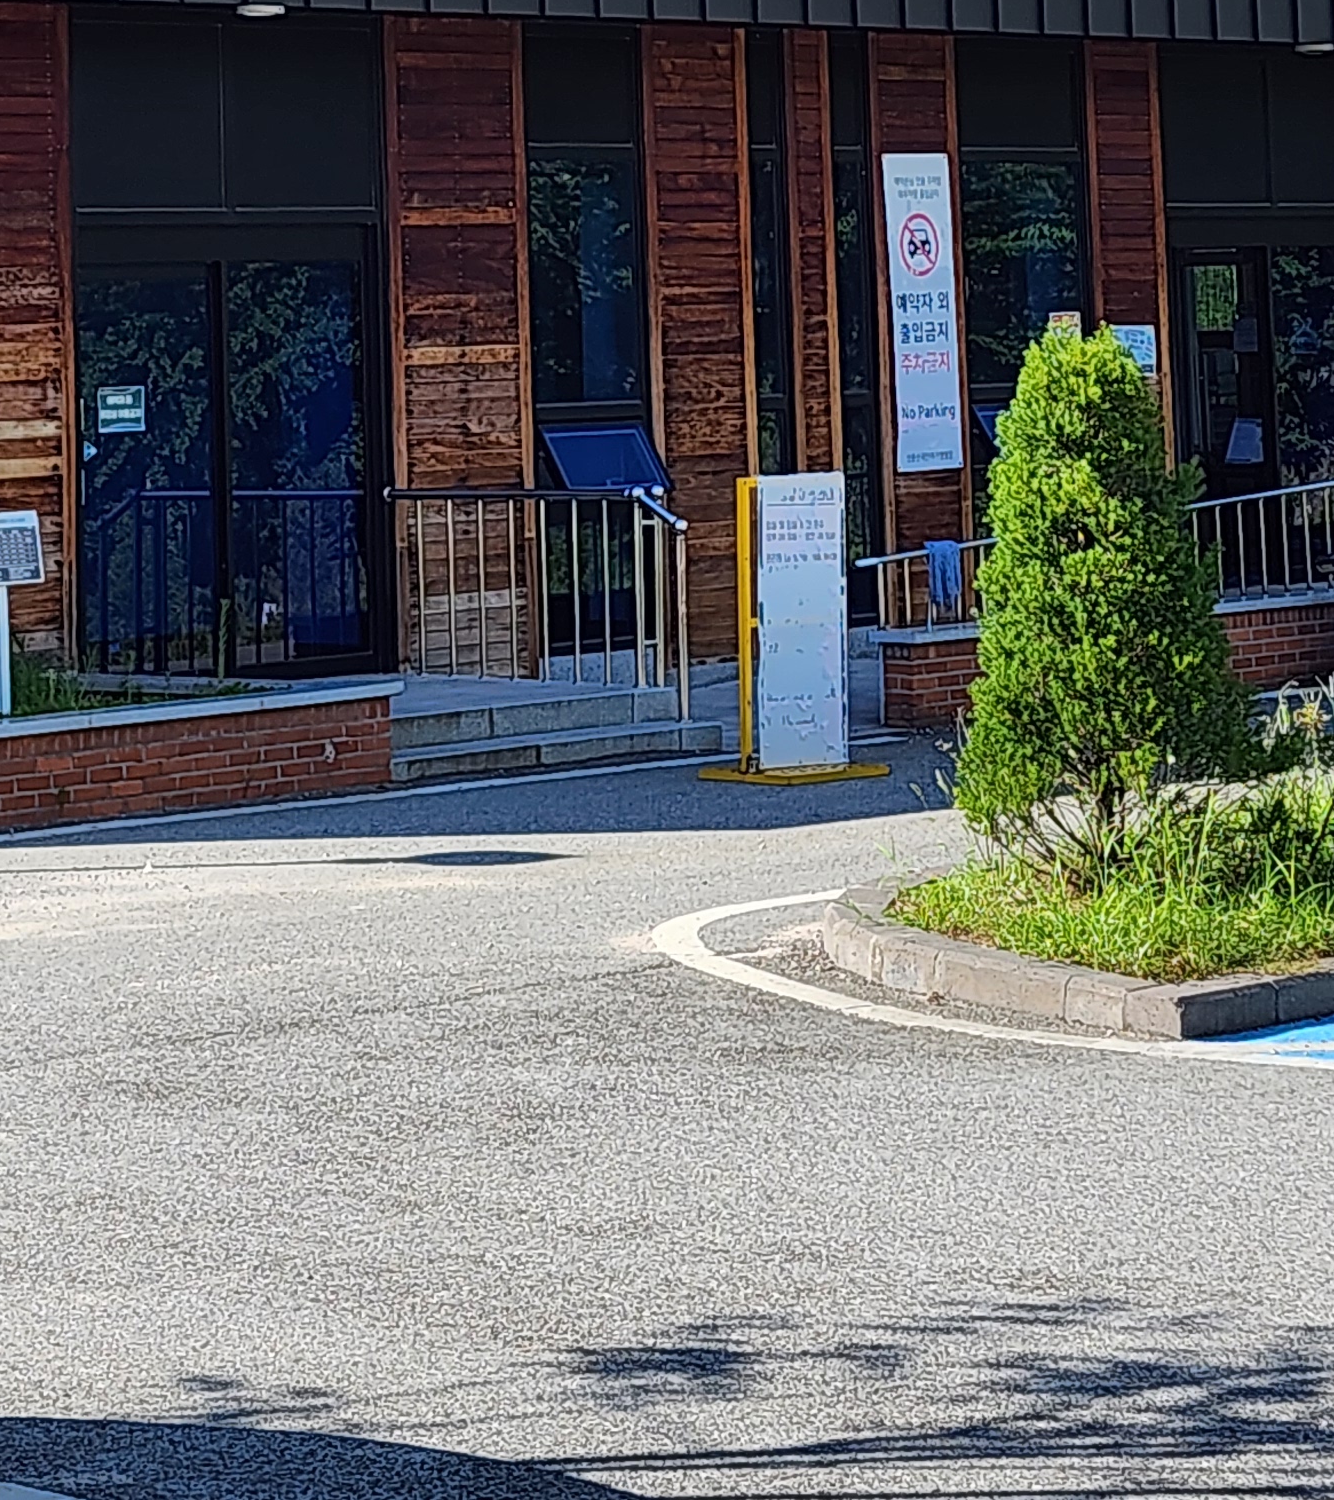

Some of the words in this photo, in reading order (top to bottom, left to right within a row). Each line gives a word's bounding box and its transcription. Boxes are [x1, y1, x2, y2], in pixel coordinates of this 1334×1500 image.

[896, 292, 934, 314] 예약자
[937, 290, 950, 314] 외
[899, 320, 950, 345] 출입금지
[901, 404, 916, 420] No
[918, 402, 956, 421] Parking
